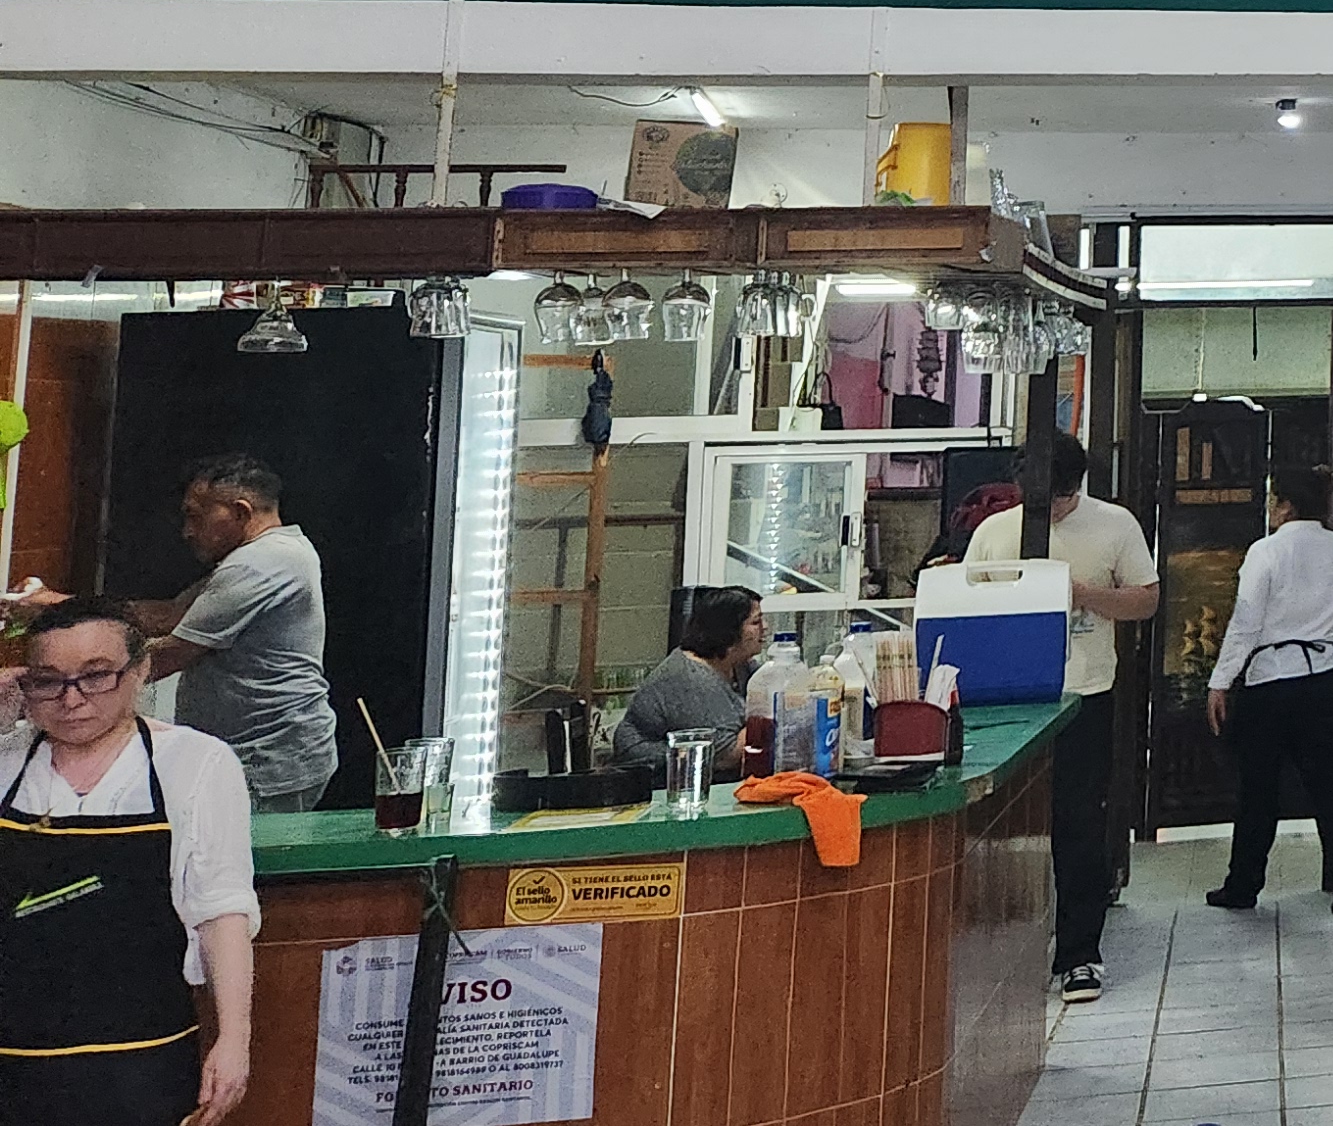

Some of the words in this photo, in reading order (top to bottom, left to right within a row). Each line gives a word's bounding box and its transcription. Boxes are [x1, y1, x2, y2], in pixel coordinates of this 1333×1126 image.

[572, 876, 581, 885] SI
[583, 875, 610, 884] TIENE
[612, 875, 621, 883] EL
[623, 874, 649, 883] SELLO
[516, 886, 525, 896] El
[527, 886, 551, 896] sello
[571, 884, 671, 901] VERIFICADO
[515, 895, 557, 905] amarillo
[557, 944, 586, 954] SALUD
[441, 978, 513, 1005] VISO
[355, 1019, 404, 1030] CONSUME
[464, 1011, 496, 1022] SANOS
[499, 1011, 504, 1019] E
[460, 1021, 510, 1033] SANITARIA
[512, 1017, 569, 1029] DETECTADA
[379, 1041, 402, 1050] ESTE
[453, 1045, 465, 1054] DE
[467, 1045, 479, 1054] LA
[481, 1041, 539, 1052] COPRISCAM
[353, 1064, 383, 1074] CALLE
[449, 1055, 485, 1066] BARRIO
[487, 1054, 499, 1063] DE
[501, 1049, 560, 1062] GUADALUPE
[488, 1064, 497, 1073] O
[498, 1063, 511, 1072] AL
[452, 1079, 534, 1096] SANITARIO
